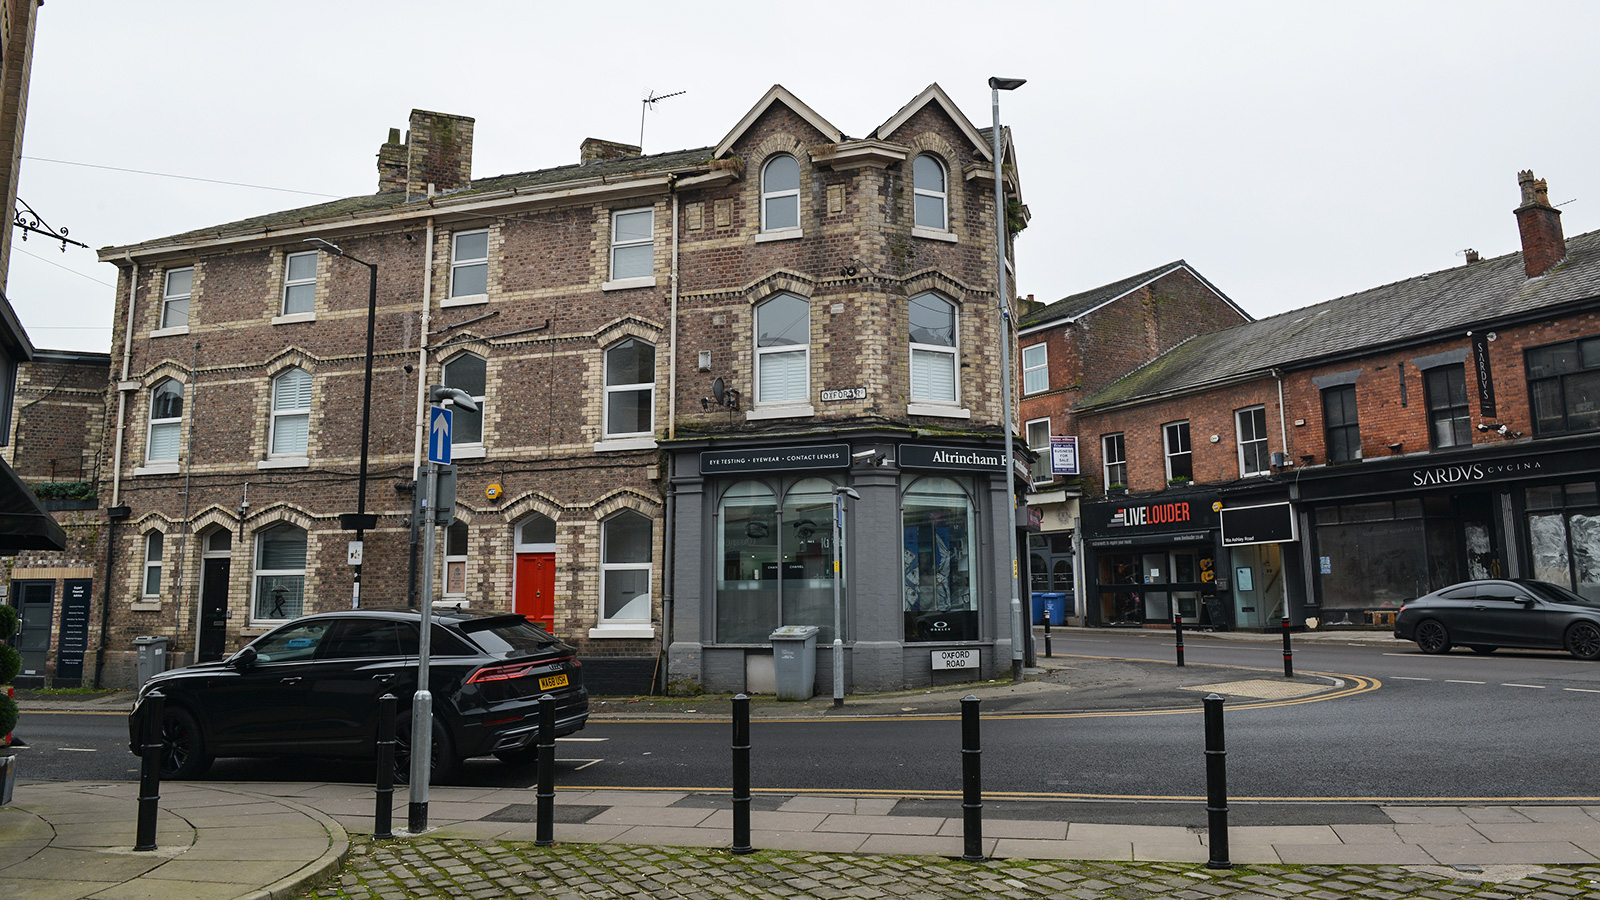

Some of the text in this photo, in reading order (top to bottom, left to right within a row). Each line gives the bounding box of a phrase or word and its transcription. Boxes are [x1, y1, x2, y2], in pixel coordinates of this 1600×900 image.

[932, 450, 998, 465] Altrincham
[1413, 461, 1541, 486] SARDVS CVCINA
[1123, 502, 1190, 527] LIVELOUDER
[941, 650, 970, 659] OXFORD
